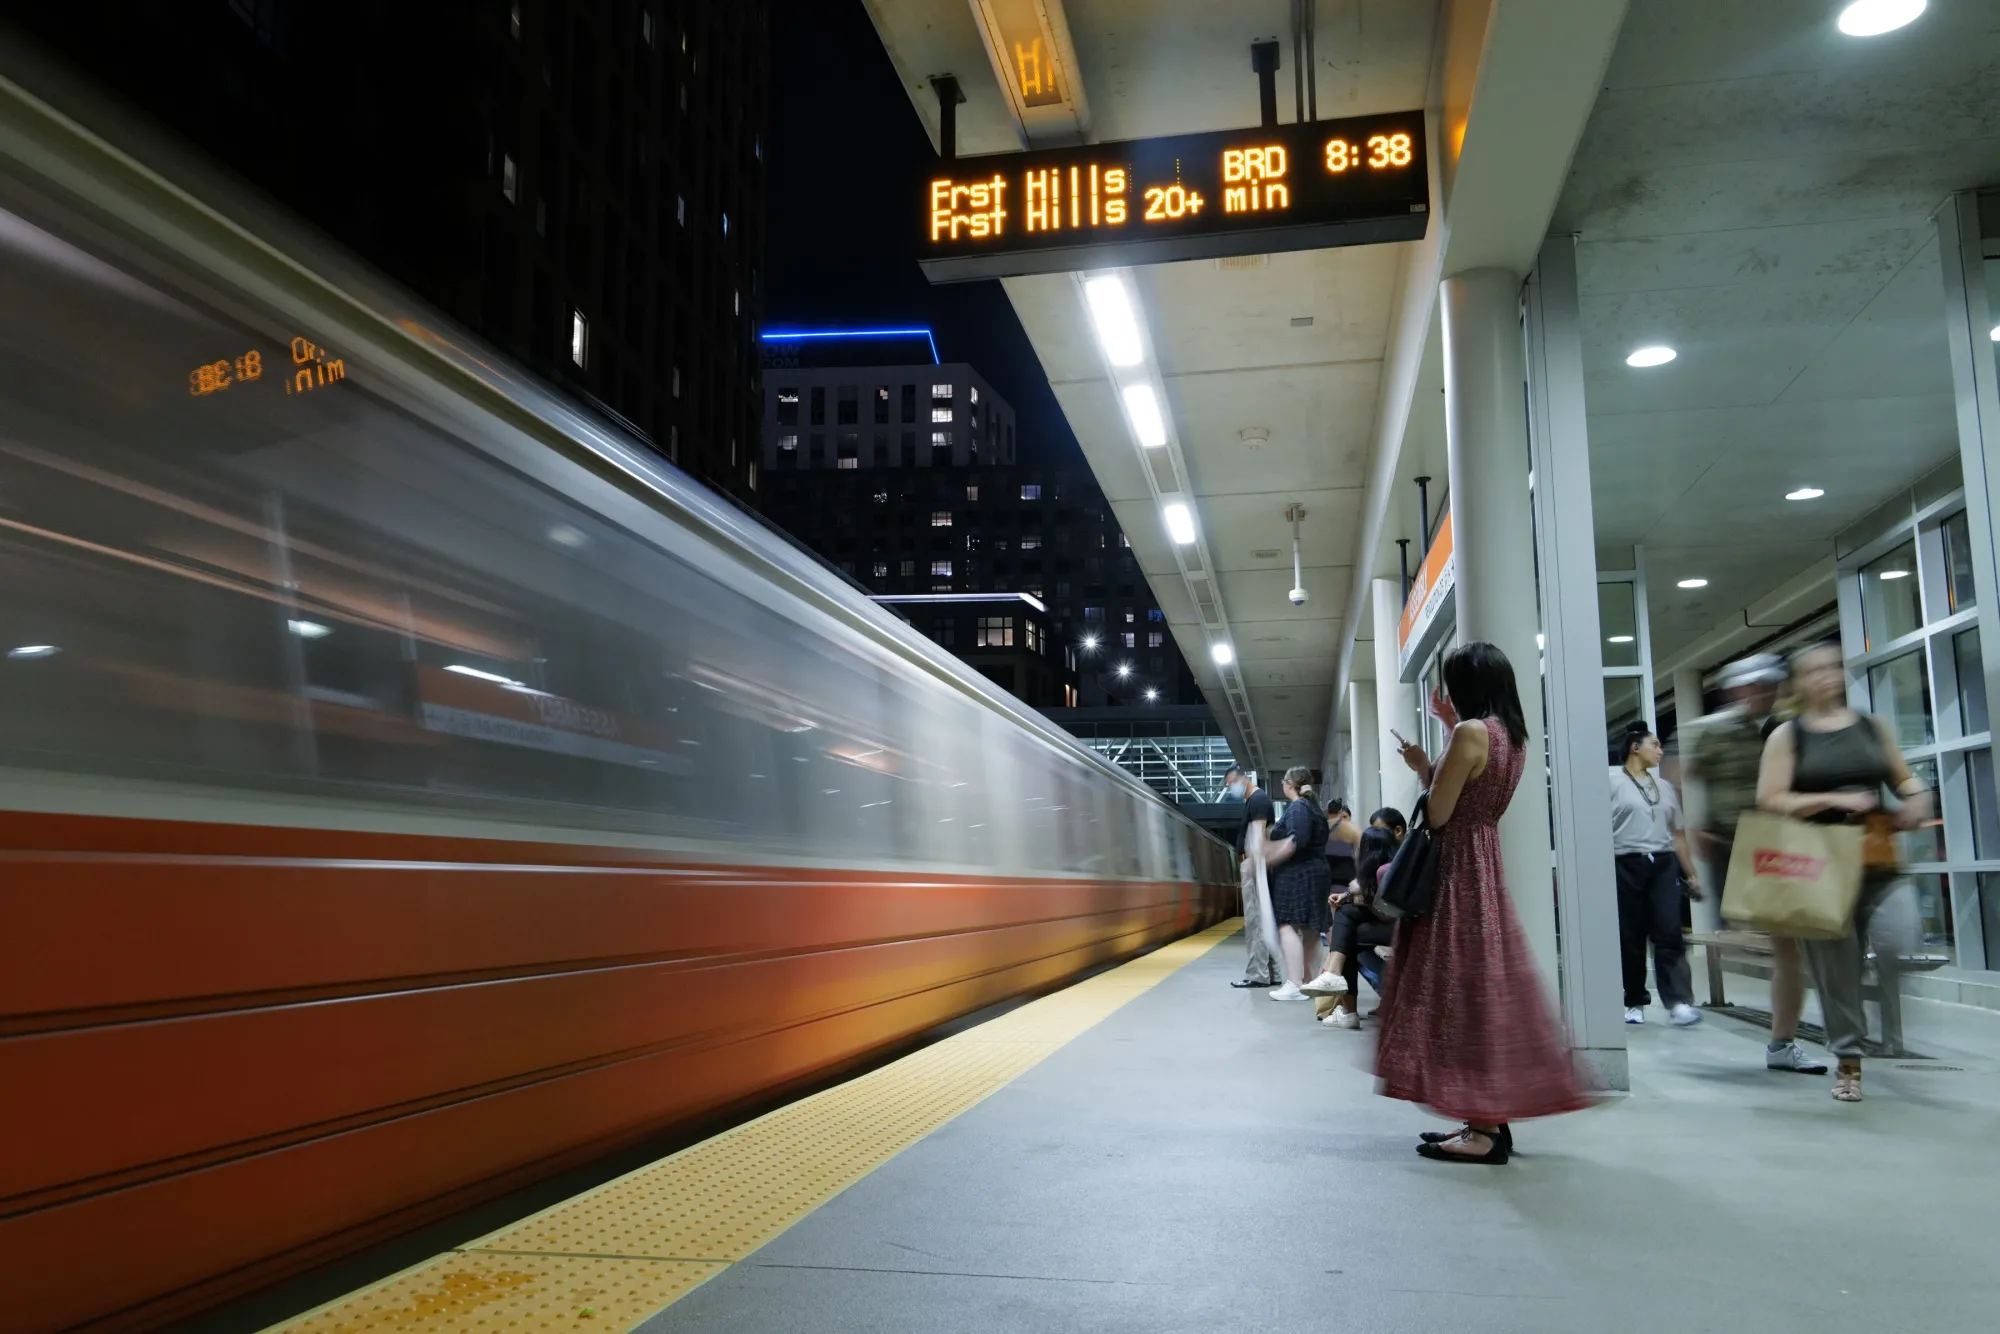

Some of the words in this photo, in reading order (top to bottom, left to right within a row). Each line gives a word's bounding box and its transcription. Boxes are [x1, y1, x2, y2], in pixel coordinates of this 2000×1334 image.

[930, 174, 1007, 211] Frst
[1025, 164, 1127, 202] Hills
[1222, 144, 1287, 182] BRD
[1325, 133, 1412, 172] 8:38
[930, 203, 1007, 241] Frst
[1025, 194, 1127, 232] Hills
[1143, 186, 1204, 221] 20+
[1223, 178, 1289, 214] min
